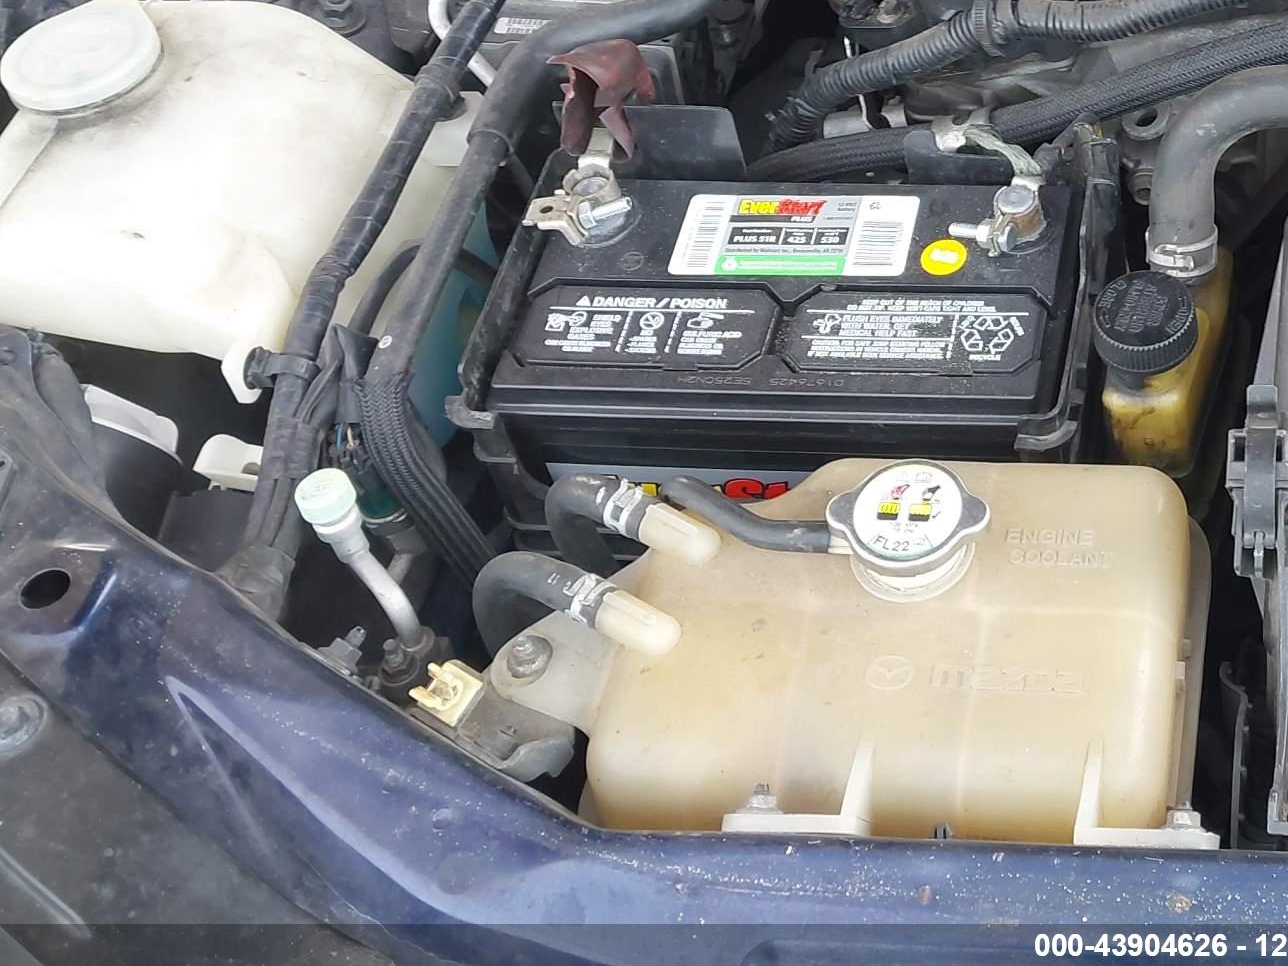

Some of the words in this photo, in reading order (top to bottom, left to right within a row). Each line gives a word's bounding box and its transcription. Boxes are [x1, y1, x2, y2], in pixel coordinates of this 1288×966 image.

[732, 235, 757, 243] PLUS
[786, 236, 807, 244] 425
[820, 236, 840, 244] 530
[591, 296, 656, 308] DANGER
[669, 297, 728, 309] POISON
[869, 315, 891, 323] EYES
[893, 322, 912, 330] GET
[1004, 528, 1097, 546] ENGINE
[873, 535, 910, 552] FL22
[1008, 549, 1114, 568] COOLANT
